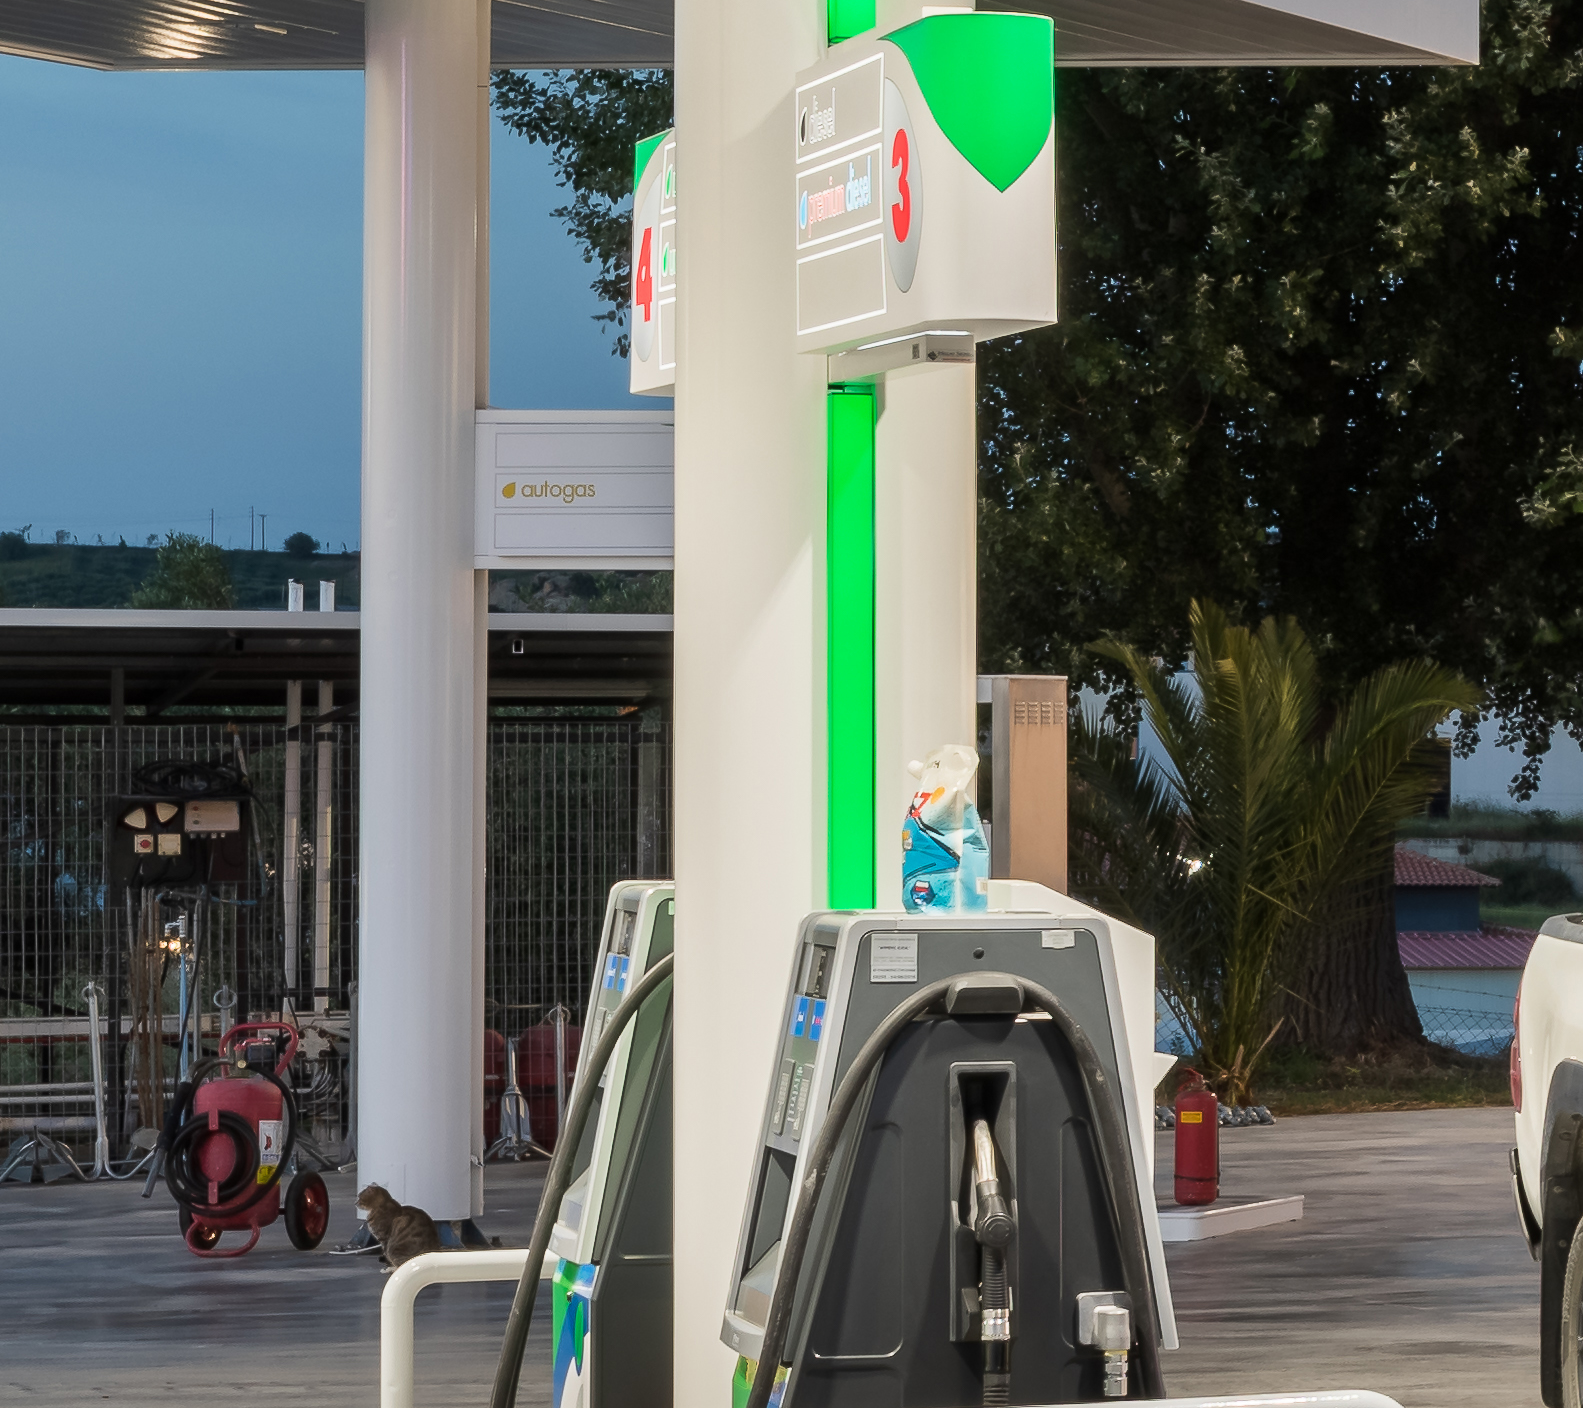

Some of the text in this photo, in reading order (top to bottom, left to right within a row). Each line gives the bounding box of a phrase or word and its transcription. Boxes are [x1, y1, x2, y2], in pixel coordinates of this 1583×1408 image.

[891, 128, 911, 243] 3
[636, 227, 652, 322] 4
[521, 480, 596, 504] autogas
